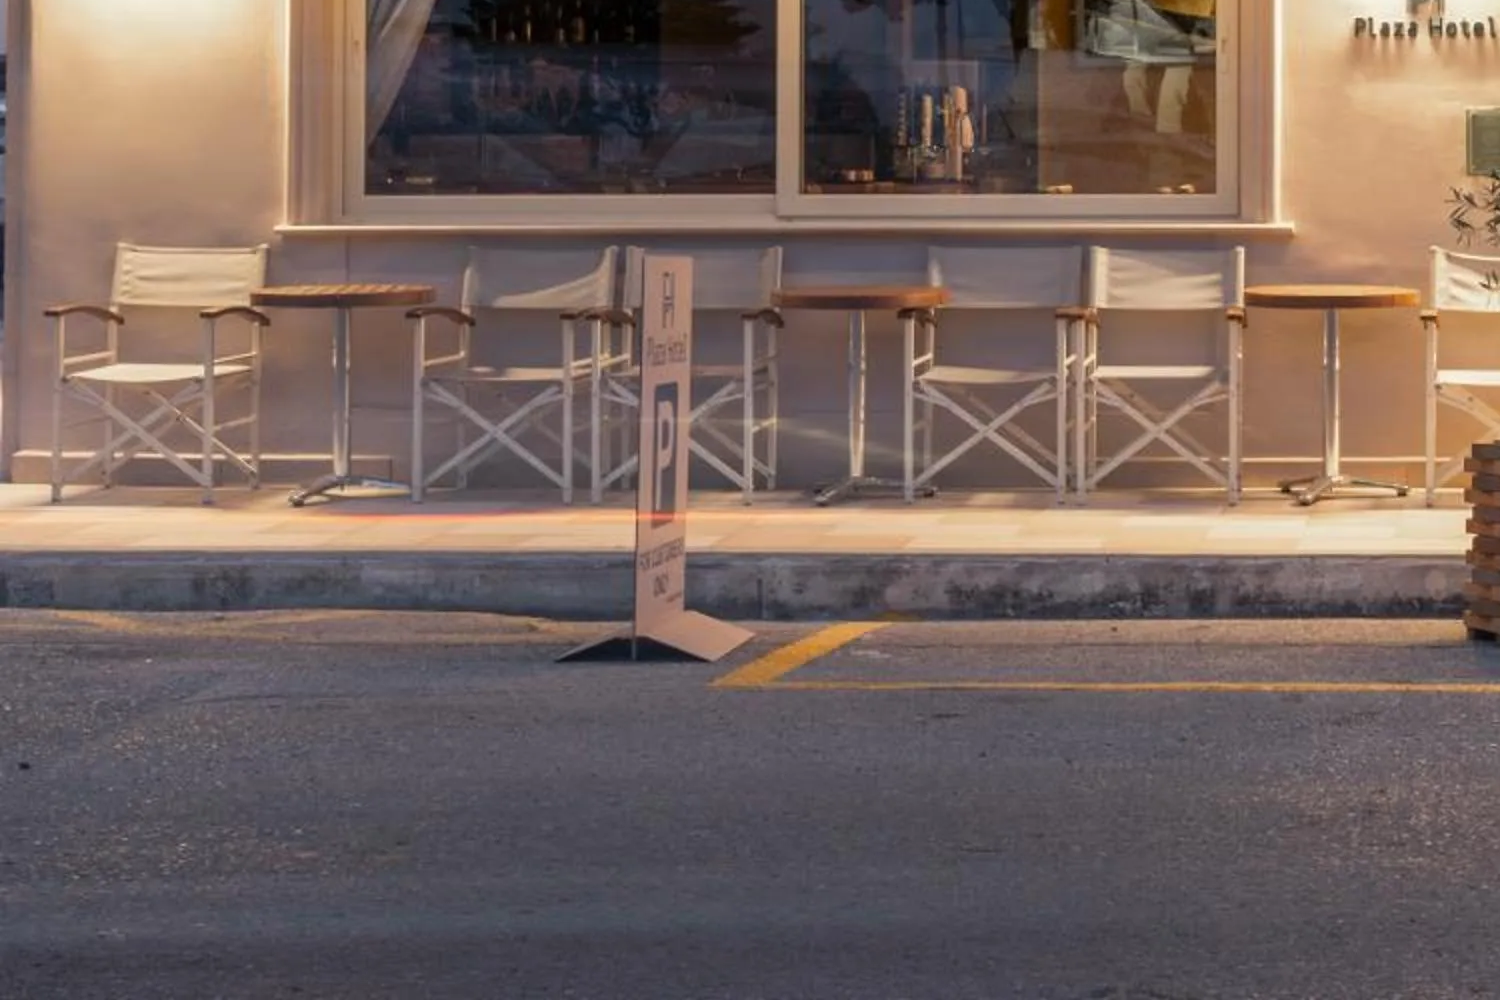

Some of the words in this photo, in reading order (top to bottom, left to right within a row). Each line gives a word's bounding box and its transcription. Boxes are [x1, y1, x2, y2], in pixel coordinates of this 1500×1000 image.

[1354, 16, 1418, 40] Plaza
[1428, 16, 1497, 40] Hotel
[656, 399, 676, 512] P
